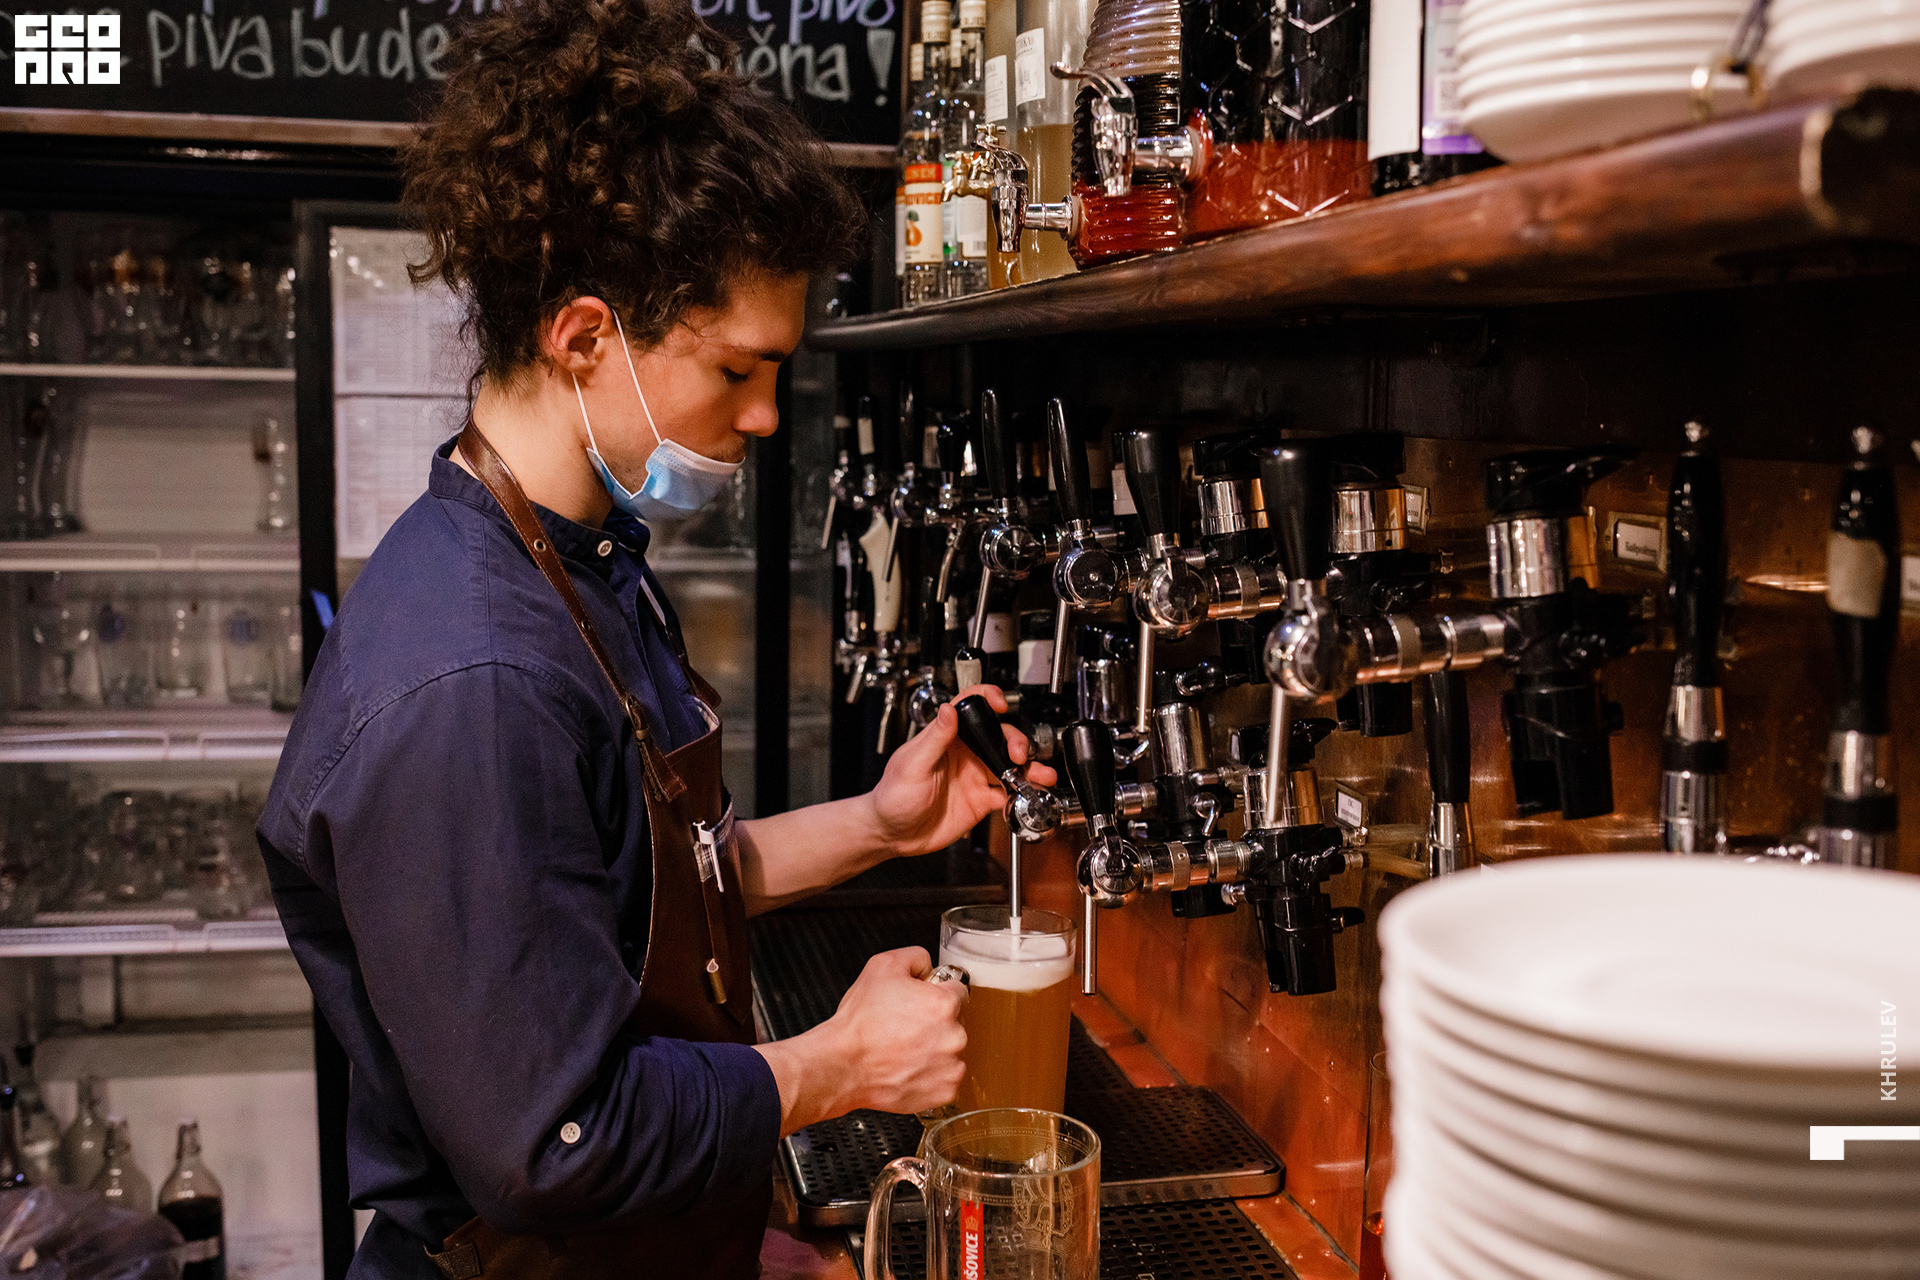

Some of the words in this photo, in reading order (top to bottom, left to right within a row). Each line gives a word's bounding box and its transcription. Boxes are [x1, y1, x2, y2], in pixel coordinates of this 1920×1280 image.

[147, 9, 275, 87] piva
[291, 6, 450, 82] bude
[963, 1231, 978, 1280] ŠOVICE
